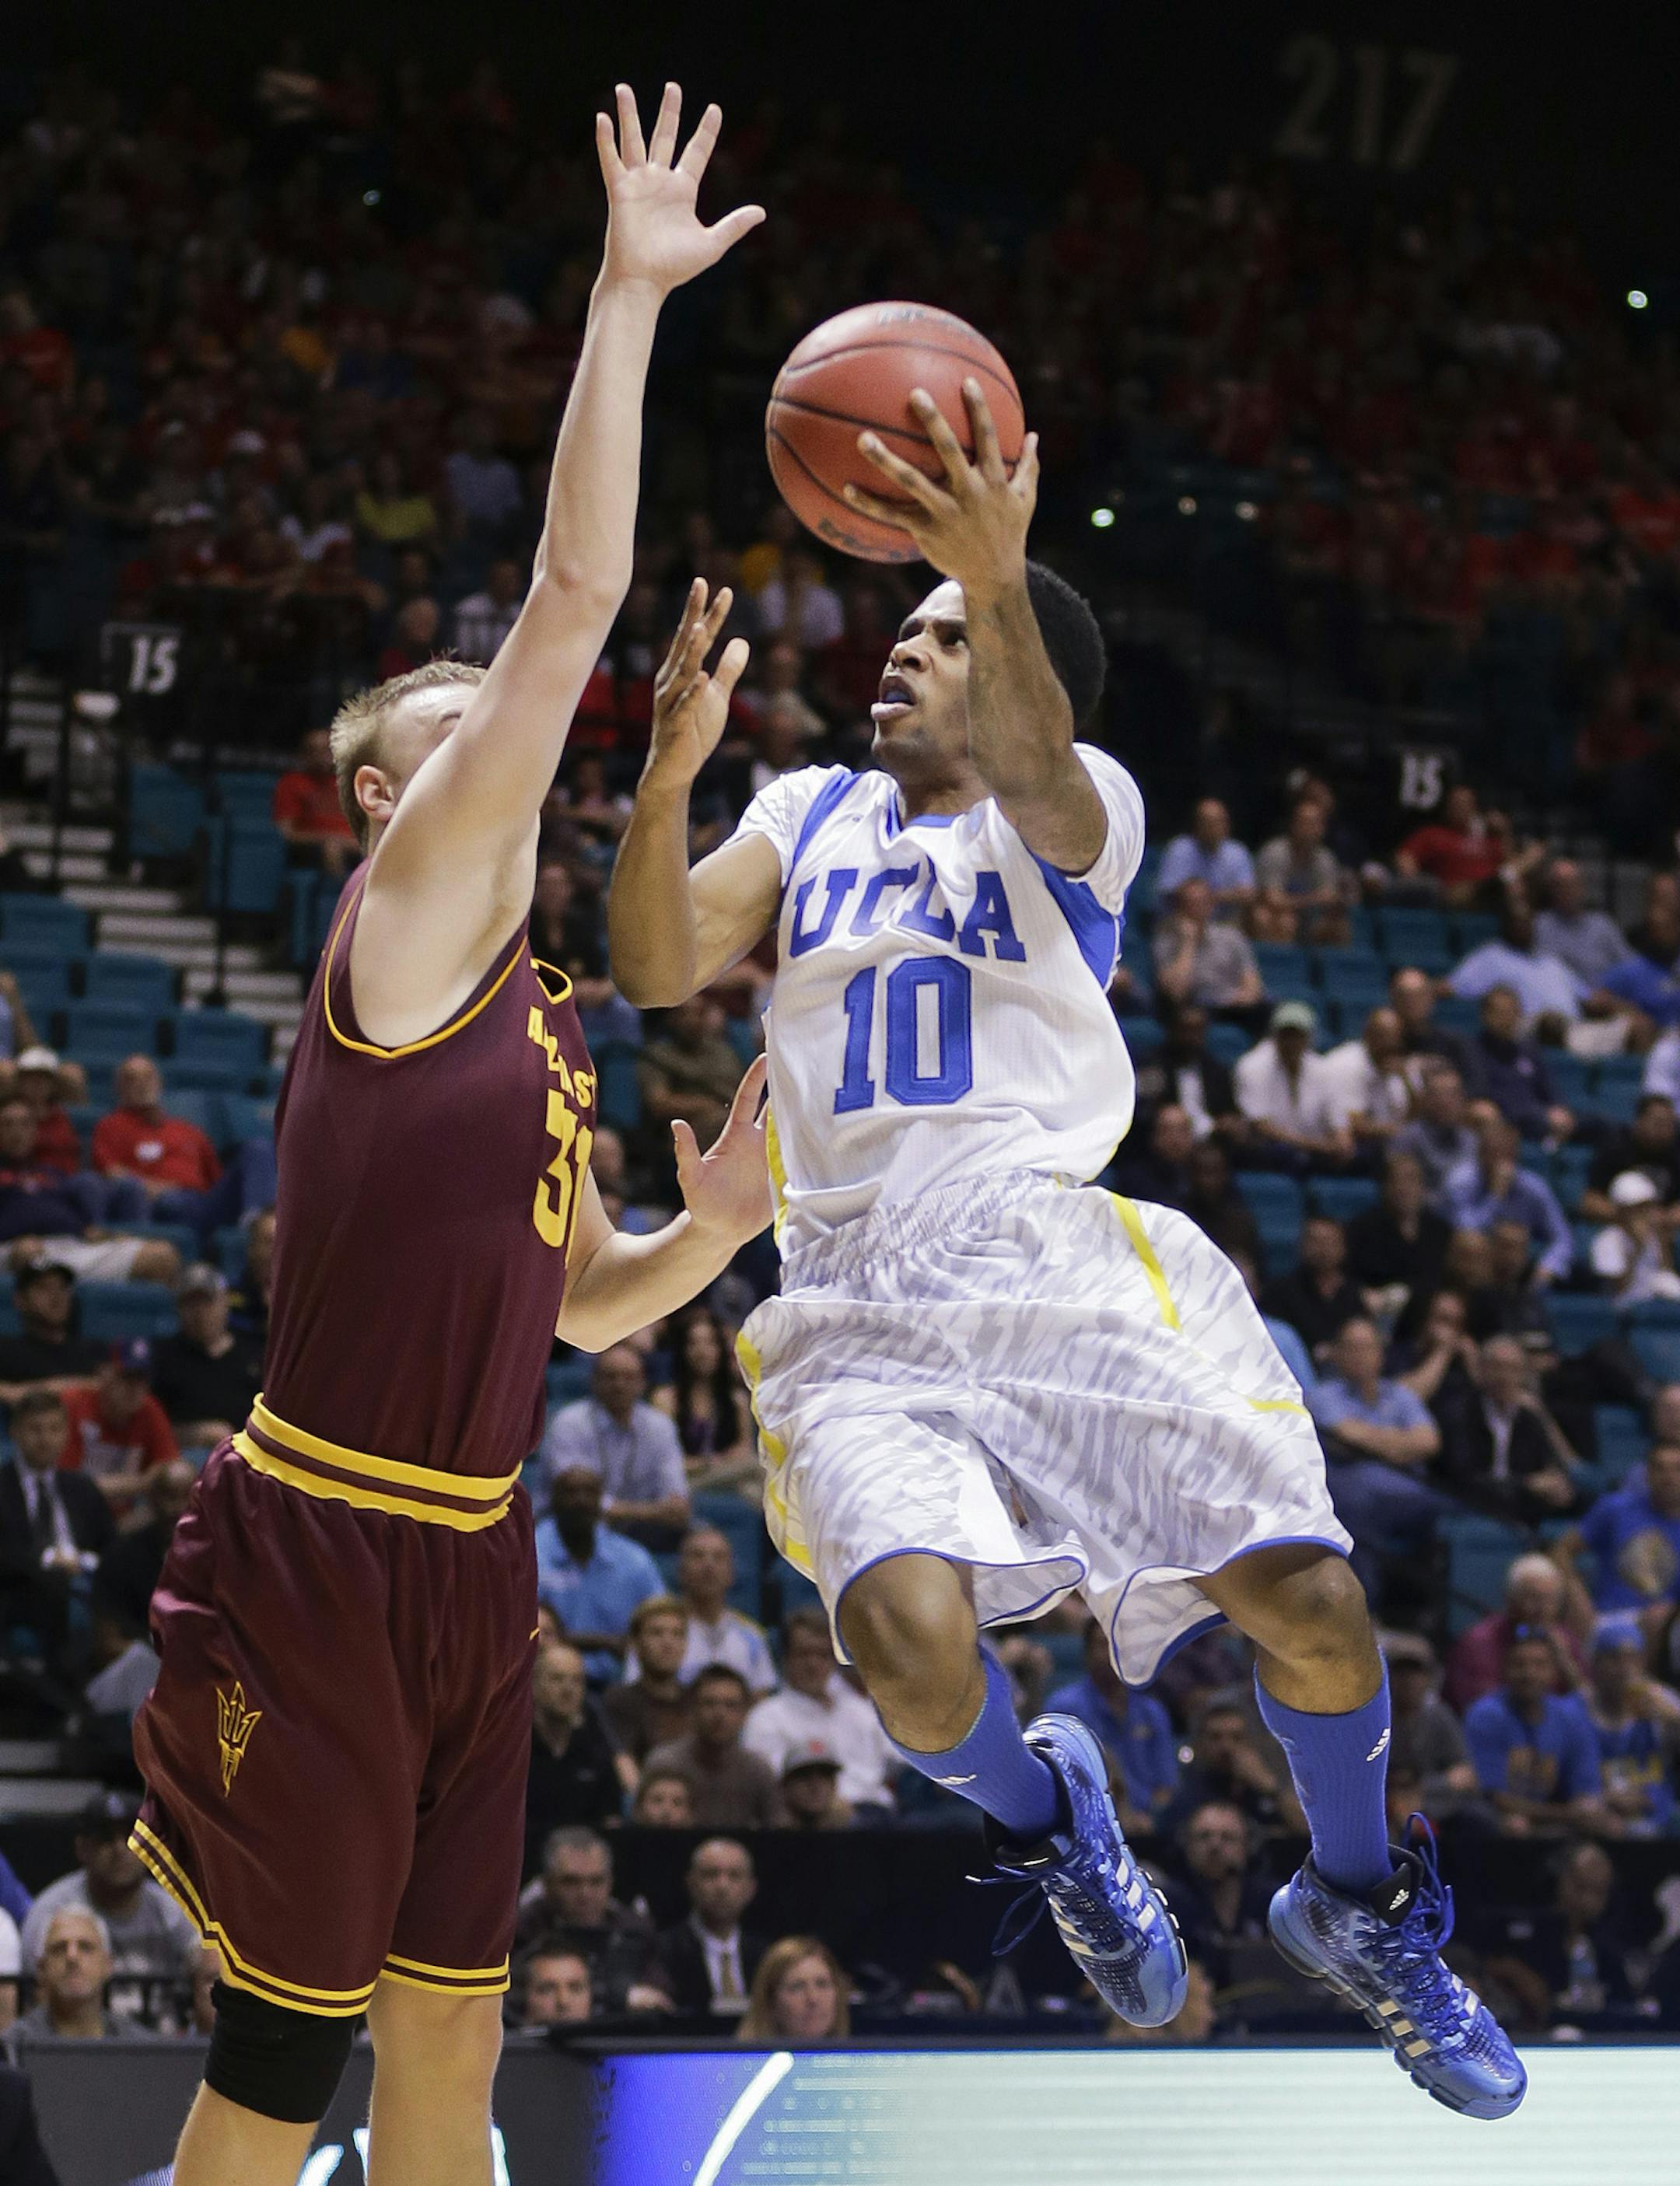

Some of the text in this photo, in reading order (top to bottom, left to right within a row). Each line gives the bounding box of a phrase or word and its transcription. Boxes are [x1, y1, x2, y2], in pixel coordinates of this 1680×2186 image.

[1271, 34, 1458, 170] 217
[130, 637, 180, 694] 15
[789, 854, 1027, 962] UCLA
[833, 955, 972, 1115] 10
